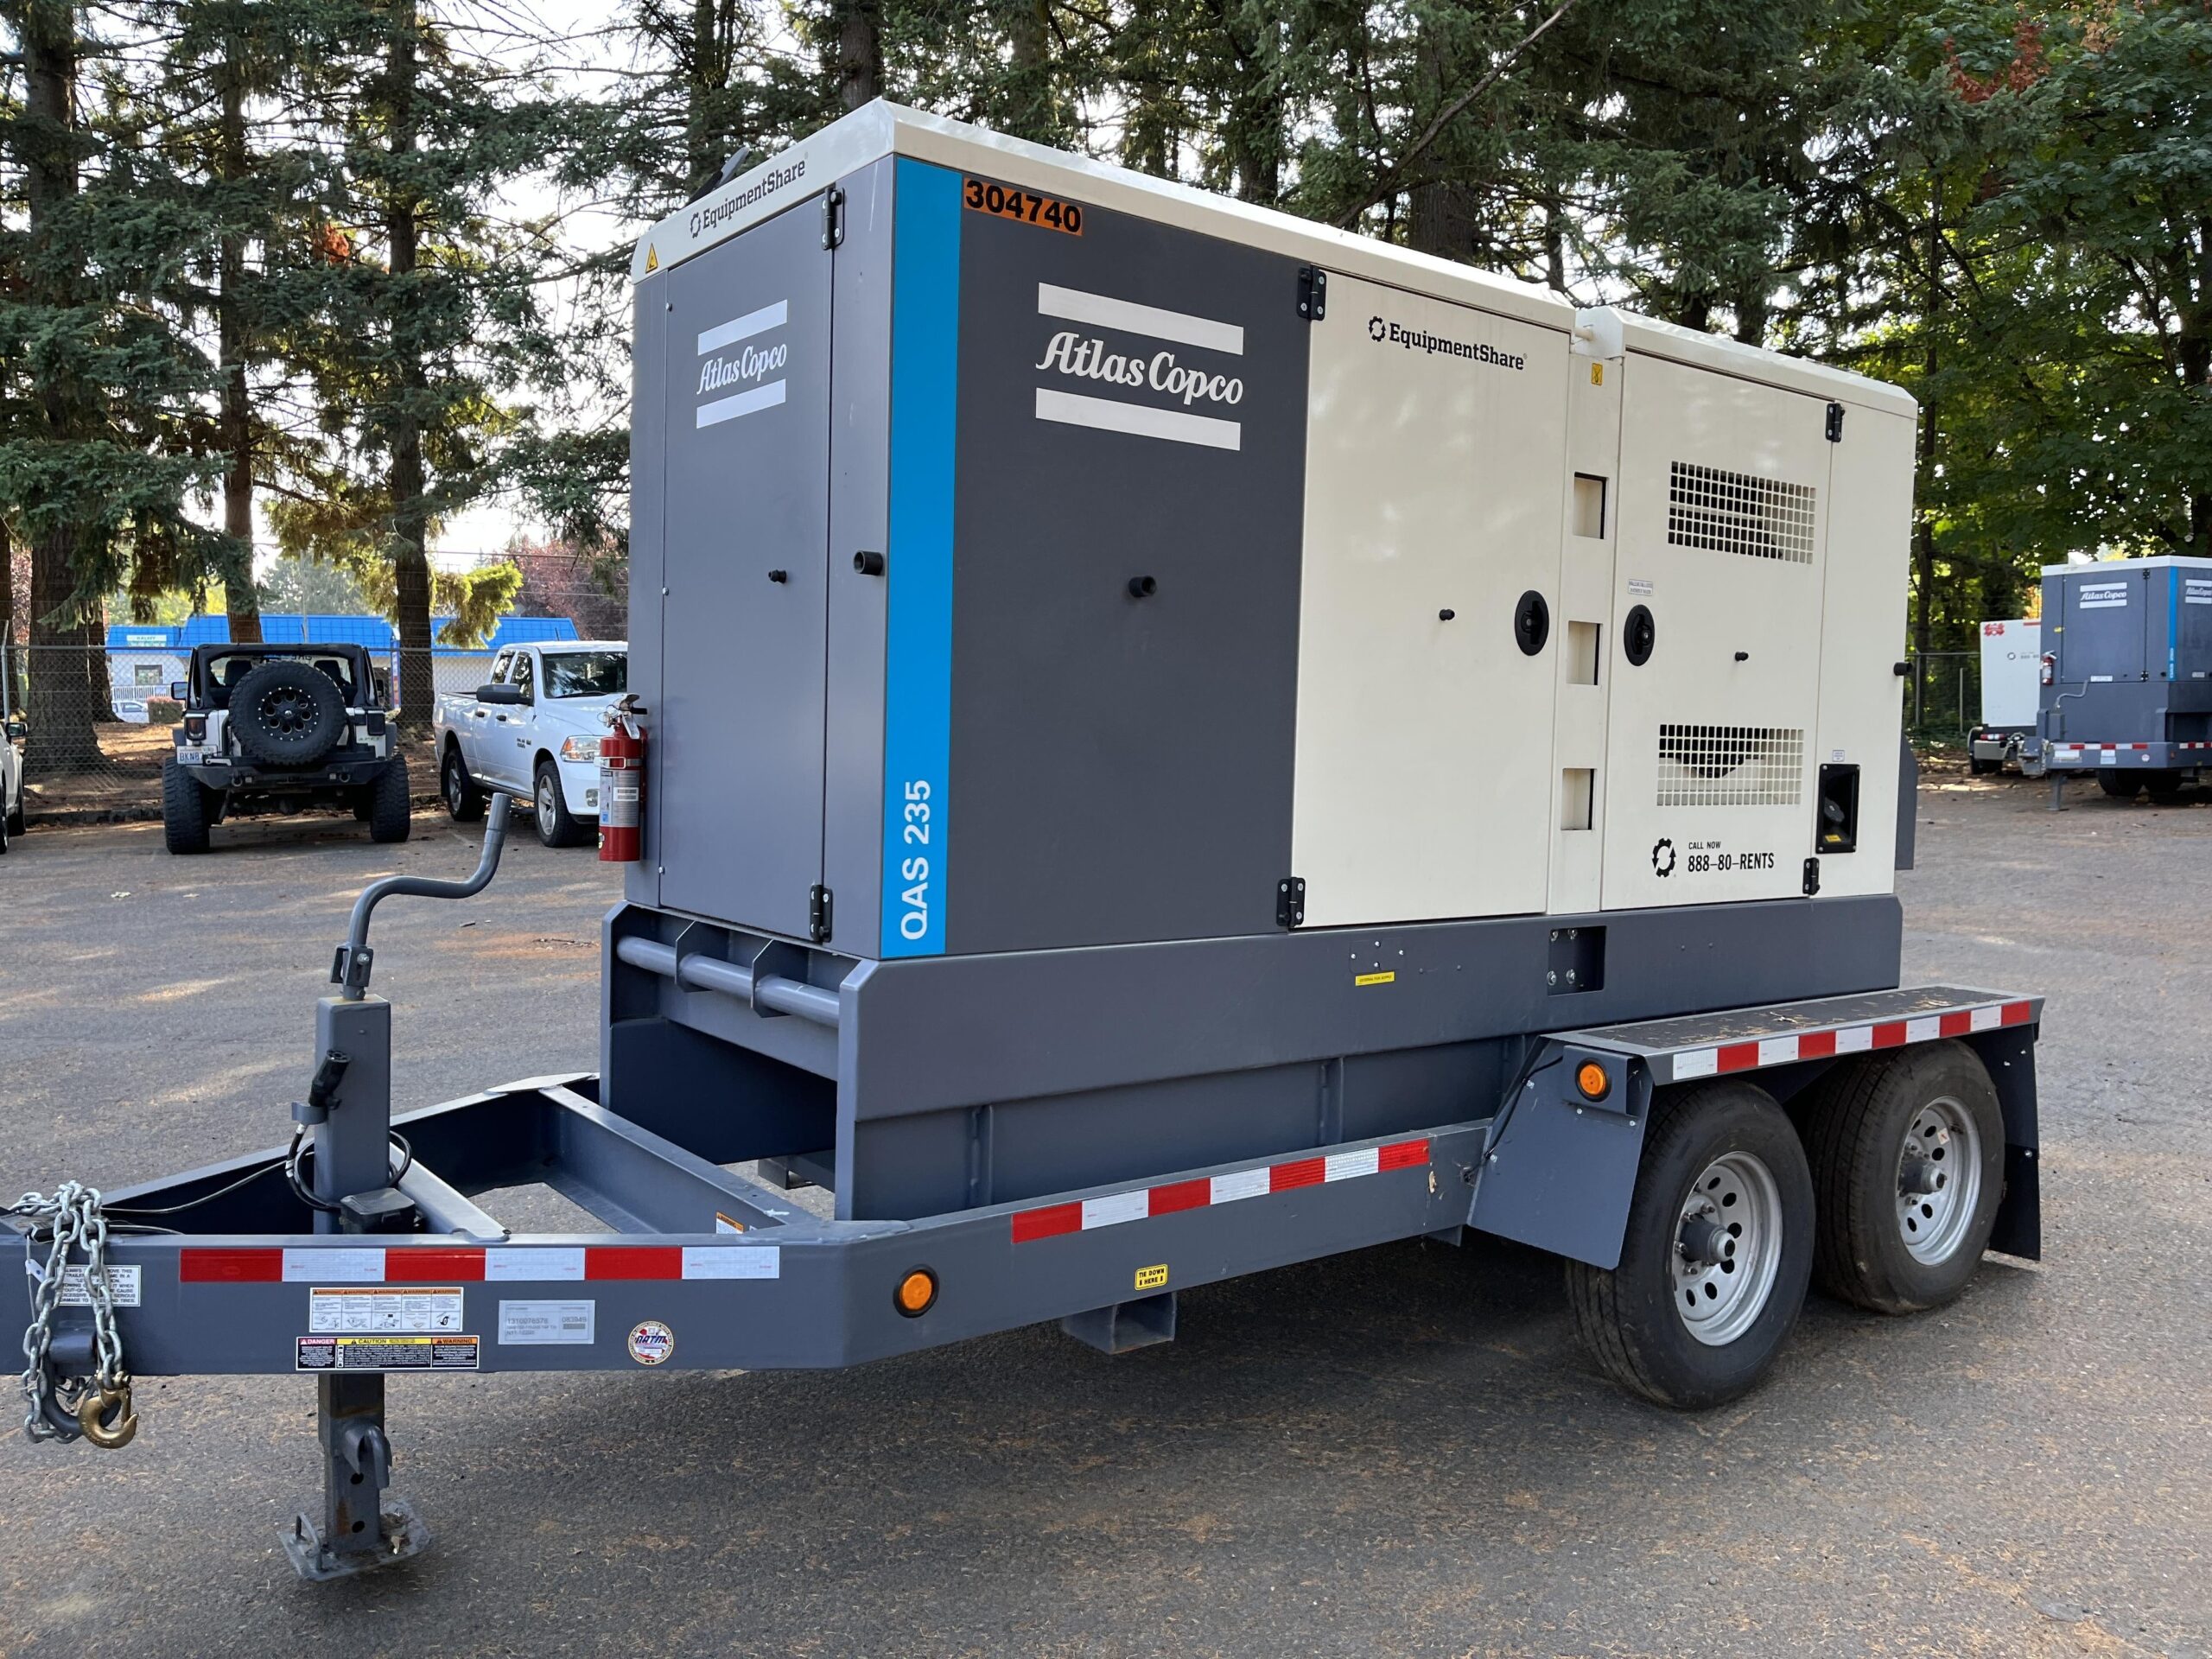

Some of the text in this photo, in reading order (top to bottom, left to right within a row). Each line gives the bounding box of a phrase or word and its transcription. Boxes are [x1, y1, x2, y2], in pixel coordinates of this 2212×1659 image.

[702, 160, 805, 230] EquipmentShare
[966, 180, 1082, 232] 304740
[696, 344, 787, 395] Atlas Copco
[1035, 331, 1244, 406] Atlas Copco
[1389, 322, 1524, 371] EquipmentShare
[2081, 591, 2126, 601] Atlas Copco
[900, 779, 931, 940] QAS 235
[1688, 841, 1721, 850] CALL NOW
[1688, 852, 1775, 873] 888-80-RENTS
[1144, 1276, 1158, 1285] HERE
[1148, 1268, 1165, 1277] DOWN
